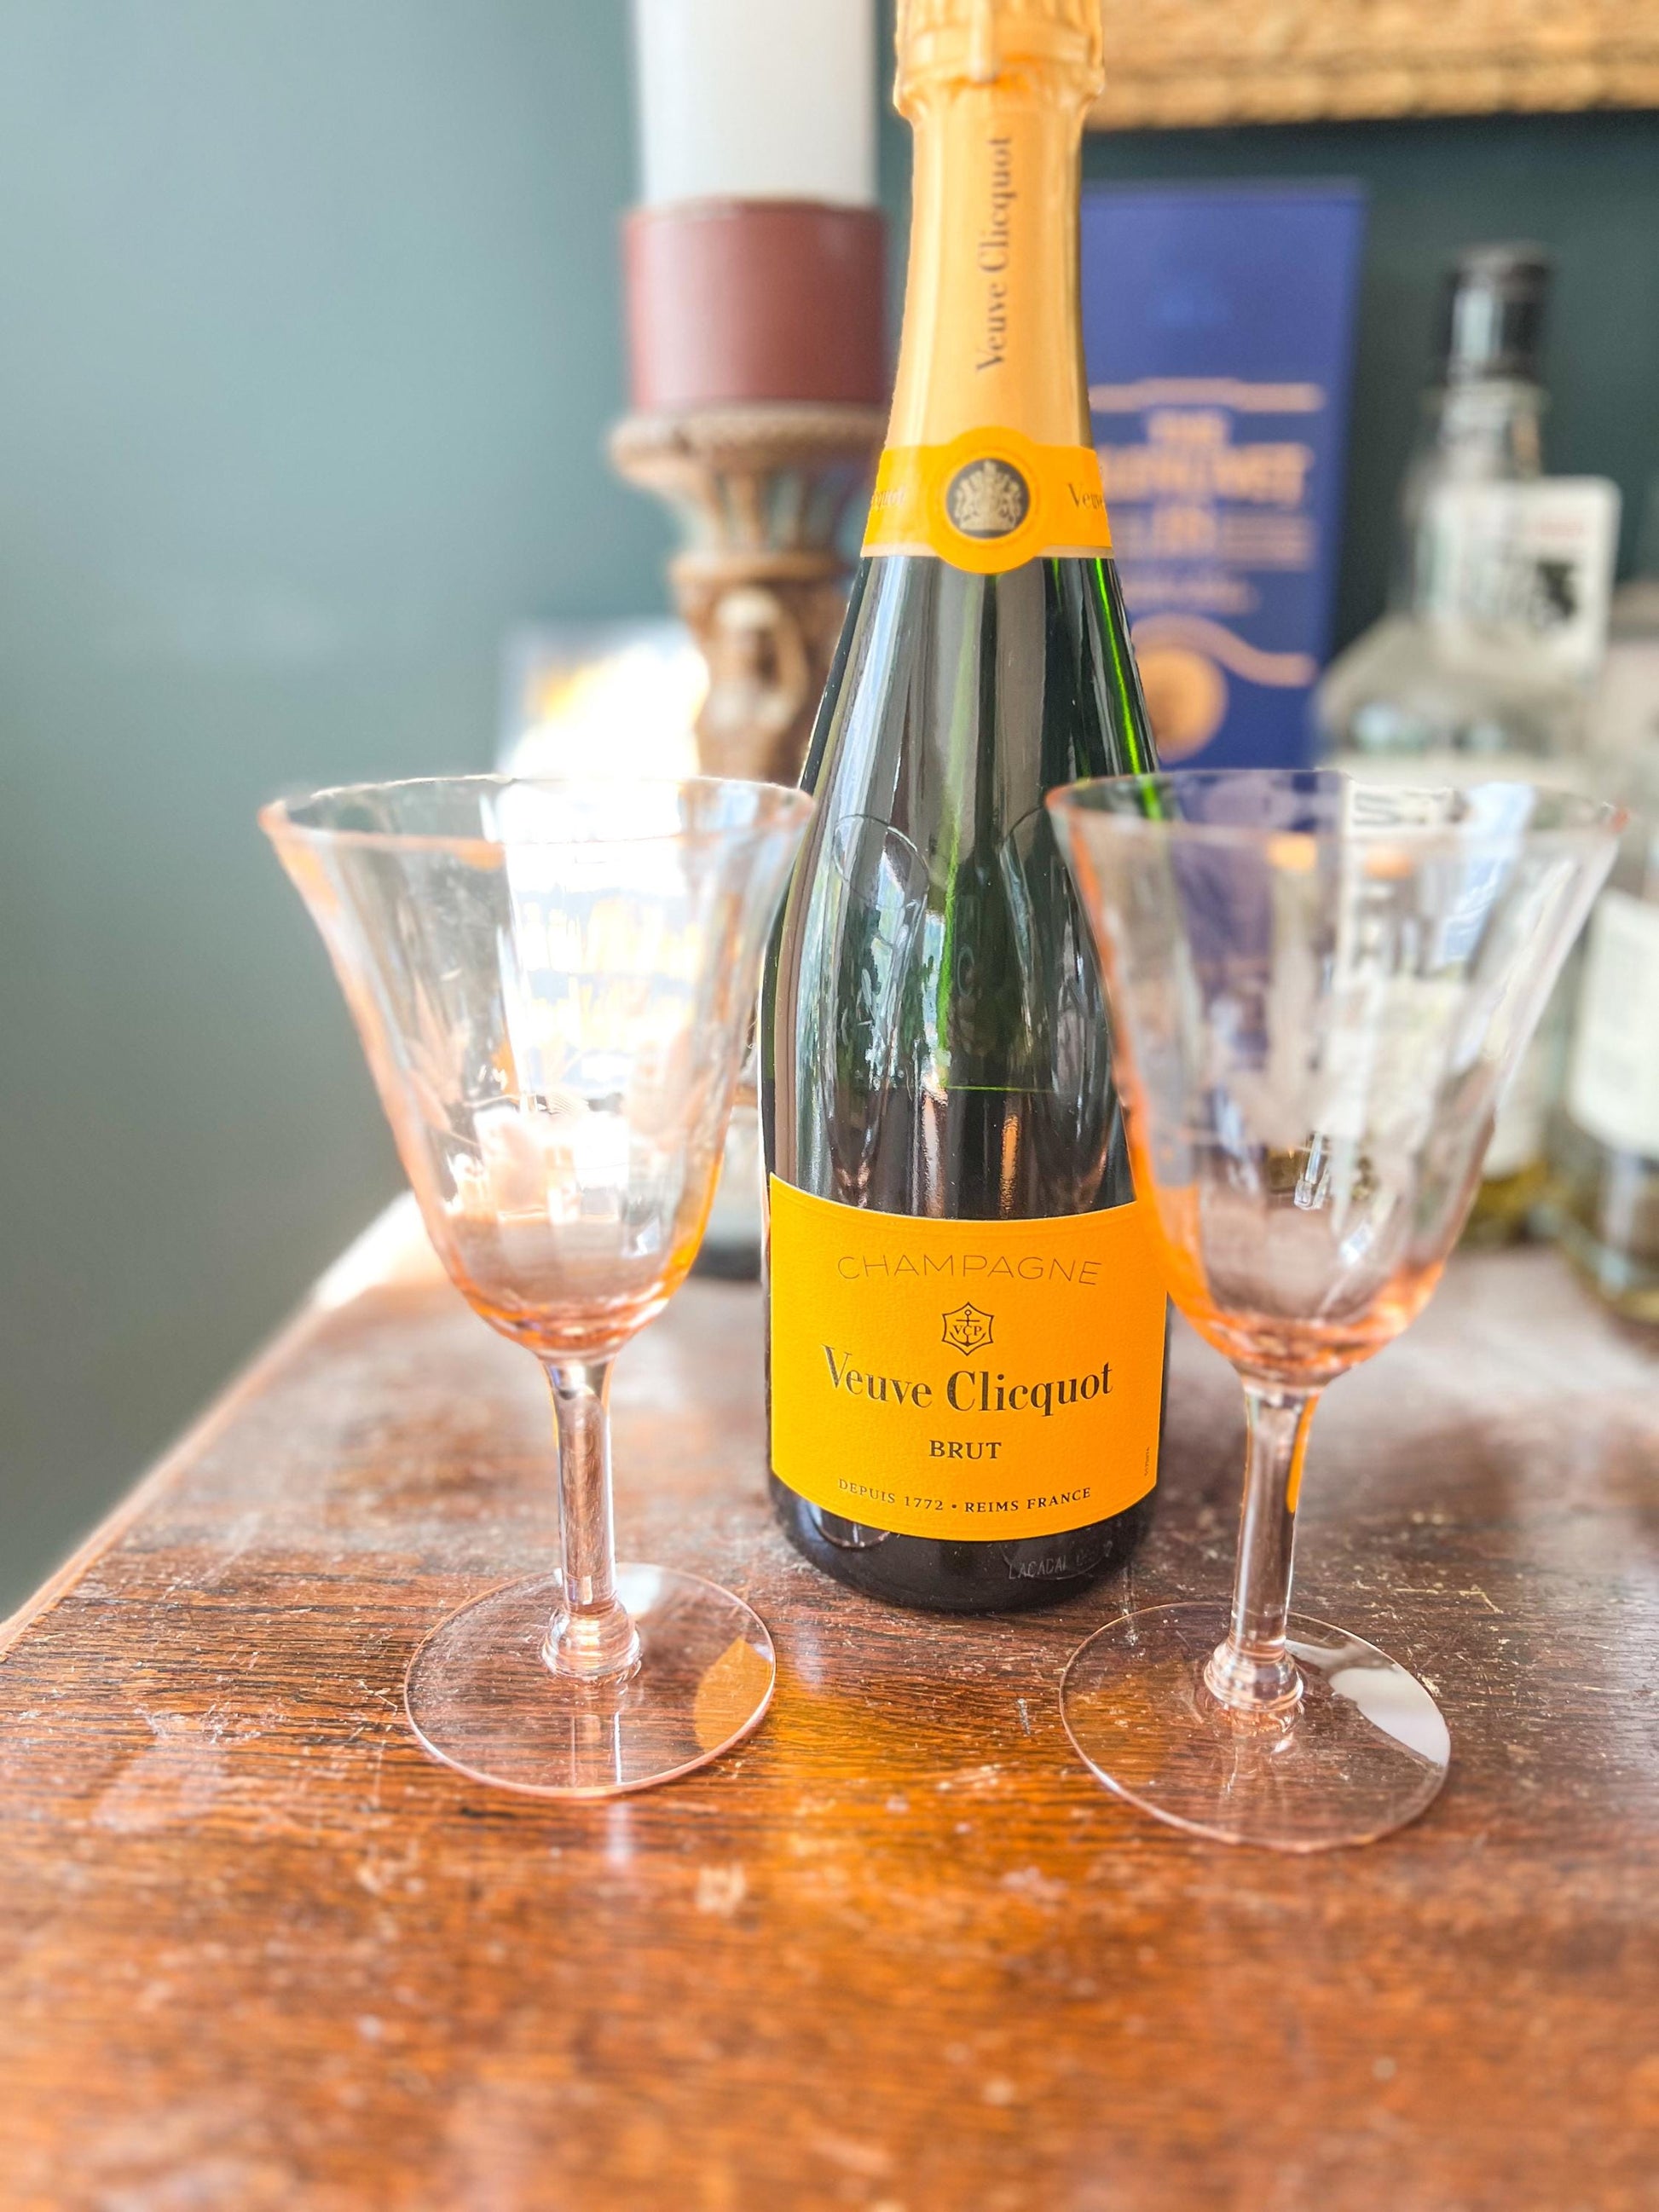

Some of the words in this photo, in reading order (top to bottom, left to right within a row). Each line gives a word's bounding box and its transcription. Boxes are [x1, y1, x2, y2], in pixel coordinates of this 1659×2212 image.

[979, 137, 1018, 273] Clicquot
[976, 281, 1007, 372] Veuve
[837, 1254, 1102, 1285] CHAMPAGNE
[821, 1343, 934, 1409] Veuve
[946, 1361, 1113, 1418] Clicquot
[928, 1439, 1003, 1459] BRUT
[838, 1478, 896, 1504] DEPUIS
[904, 1496, 944, 1511] 1772
[964, 1501, 1020, 1513] REIMS
[1026, 1487, 1091, 1510] FRANCE
